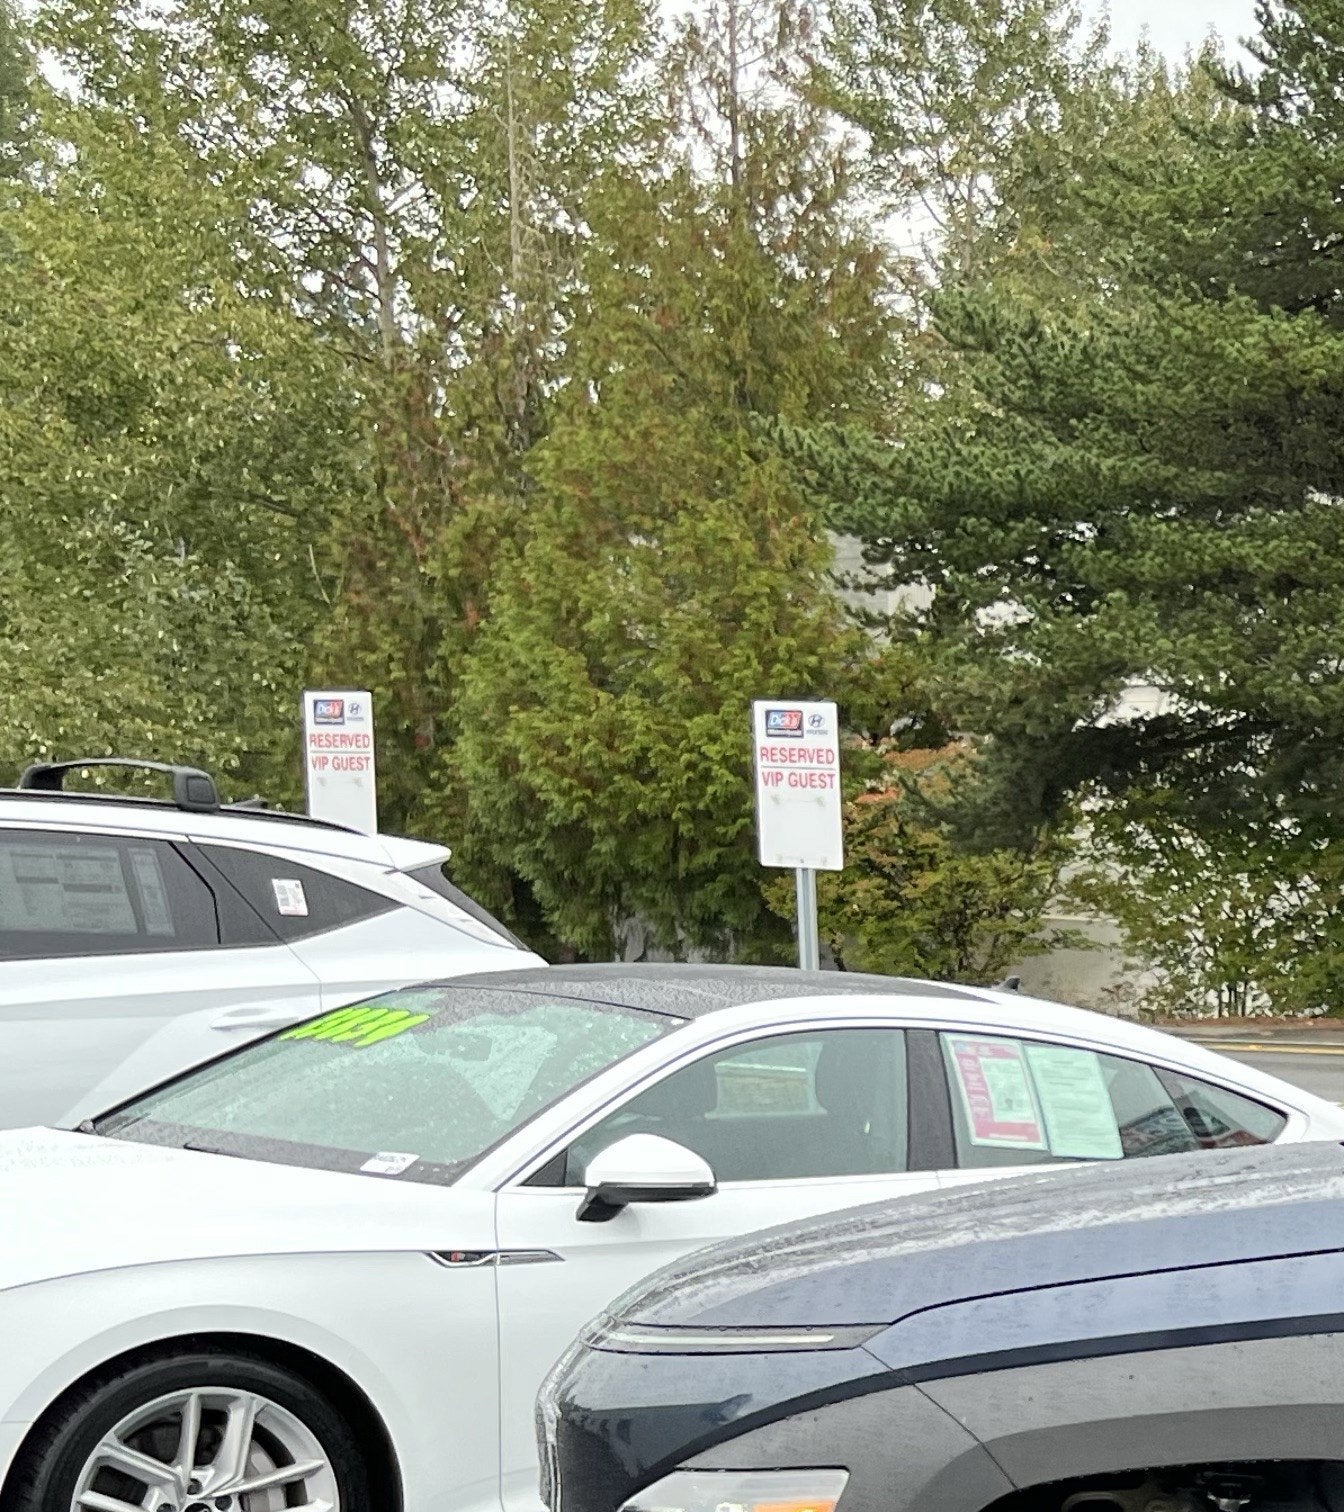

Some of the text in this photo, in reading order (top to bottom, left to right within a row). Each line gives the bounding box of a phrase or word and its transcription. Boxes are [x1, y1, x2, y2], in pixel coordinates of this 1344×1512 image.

[309, 733, 370, 749] RESERVED
[311, 756, 371, 772] VIP GUEST
[760, 746, 835, 765] RESERVED
[762, 771, 836, 790] VIP GUEST
